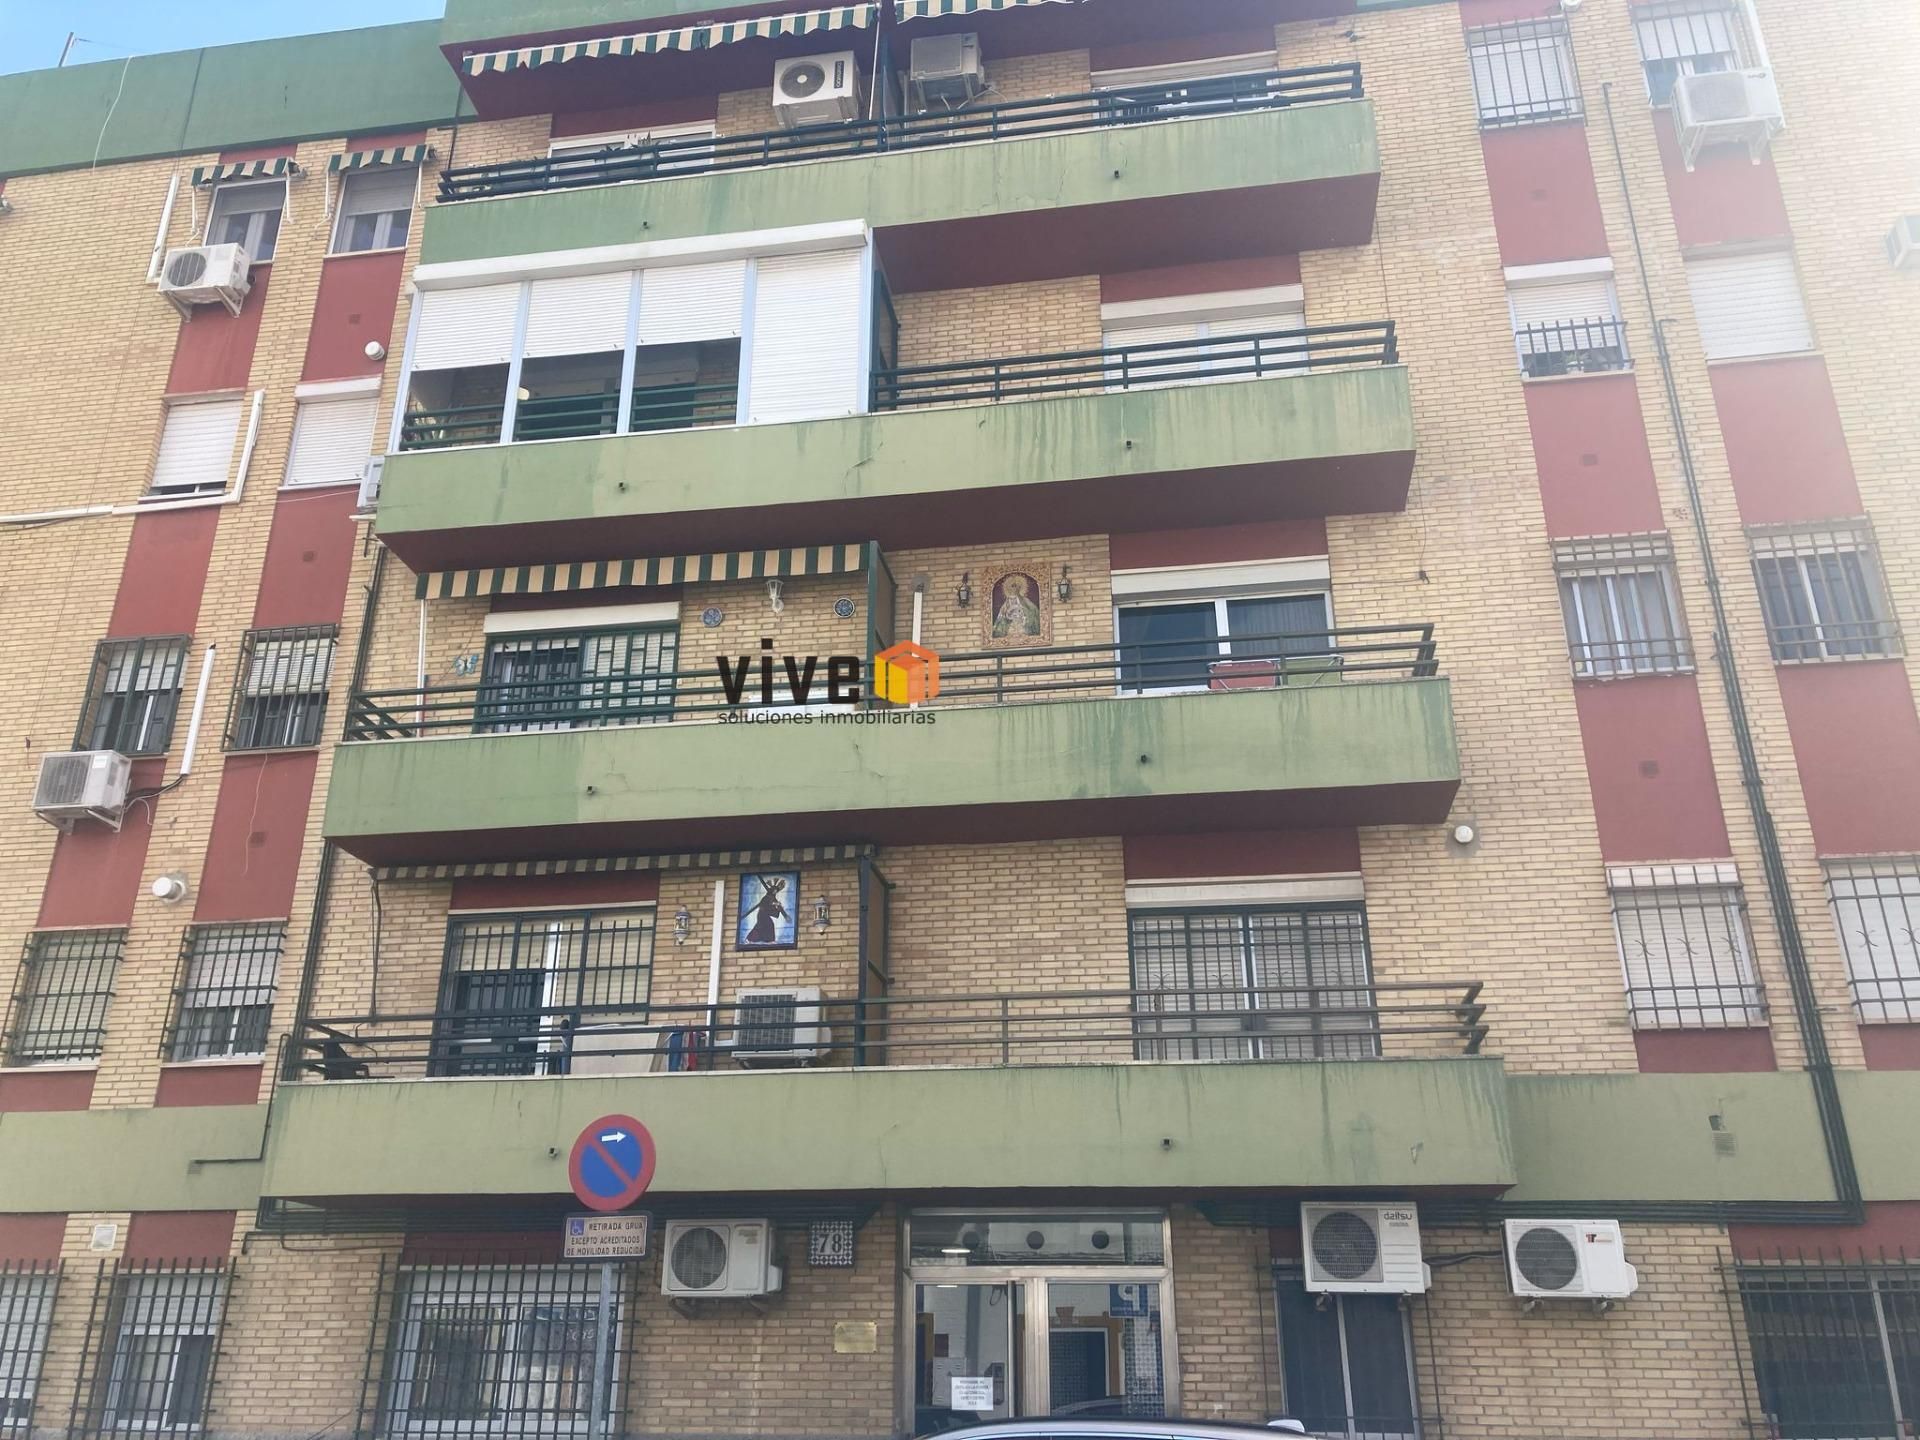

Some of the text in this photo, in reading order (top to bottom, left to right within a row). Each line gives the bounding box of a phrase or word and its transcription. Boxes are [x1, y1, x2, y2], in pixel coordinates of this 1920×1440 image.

[588, 1221, 643, 1231] RETIRADA GRUA
[571, 1235, 640, 1245] EXCEPTO ACREDITADOS
[819, 1232, 842, 1254] 78
[566, 1247, 575, 1256] DE
[577, 1246, 610, 1256] MOVILIDAD
